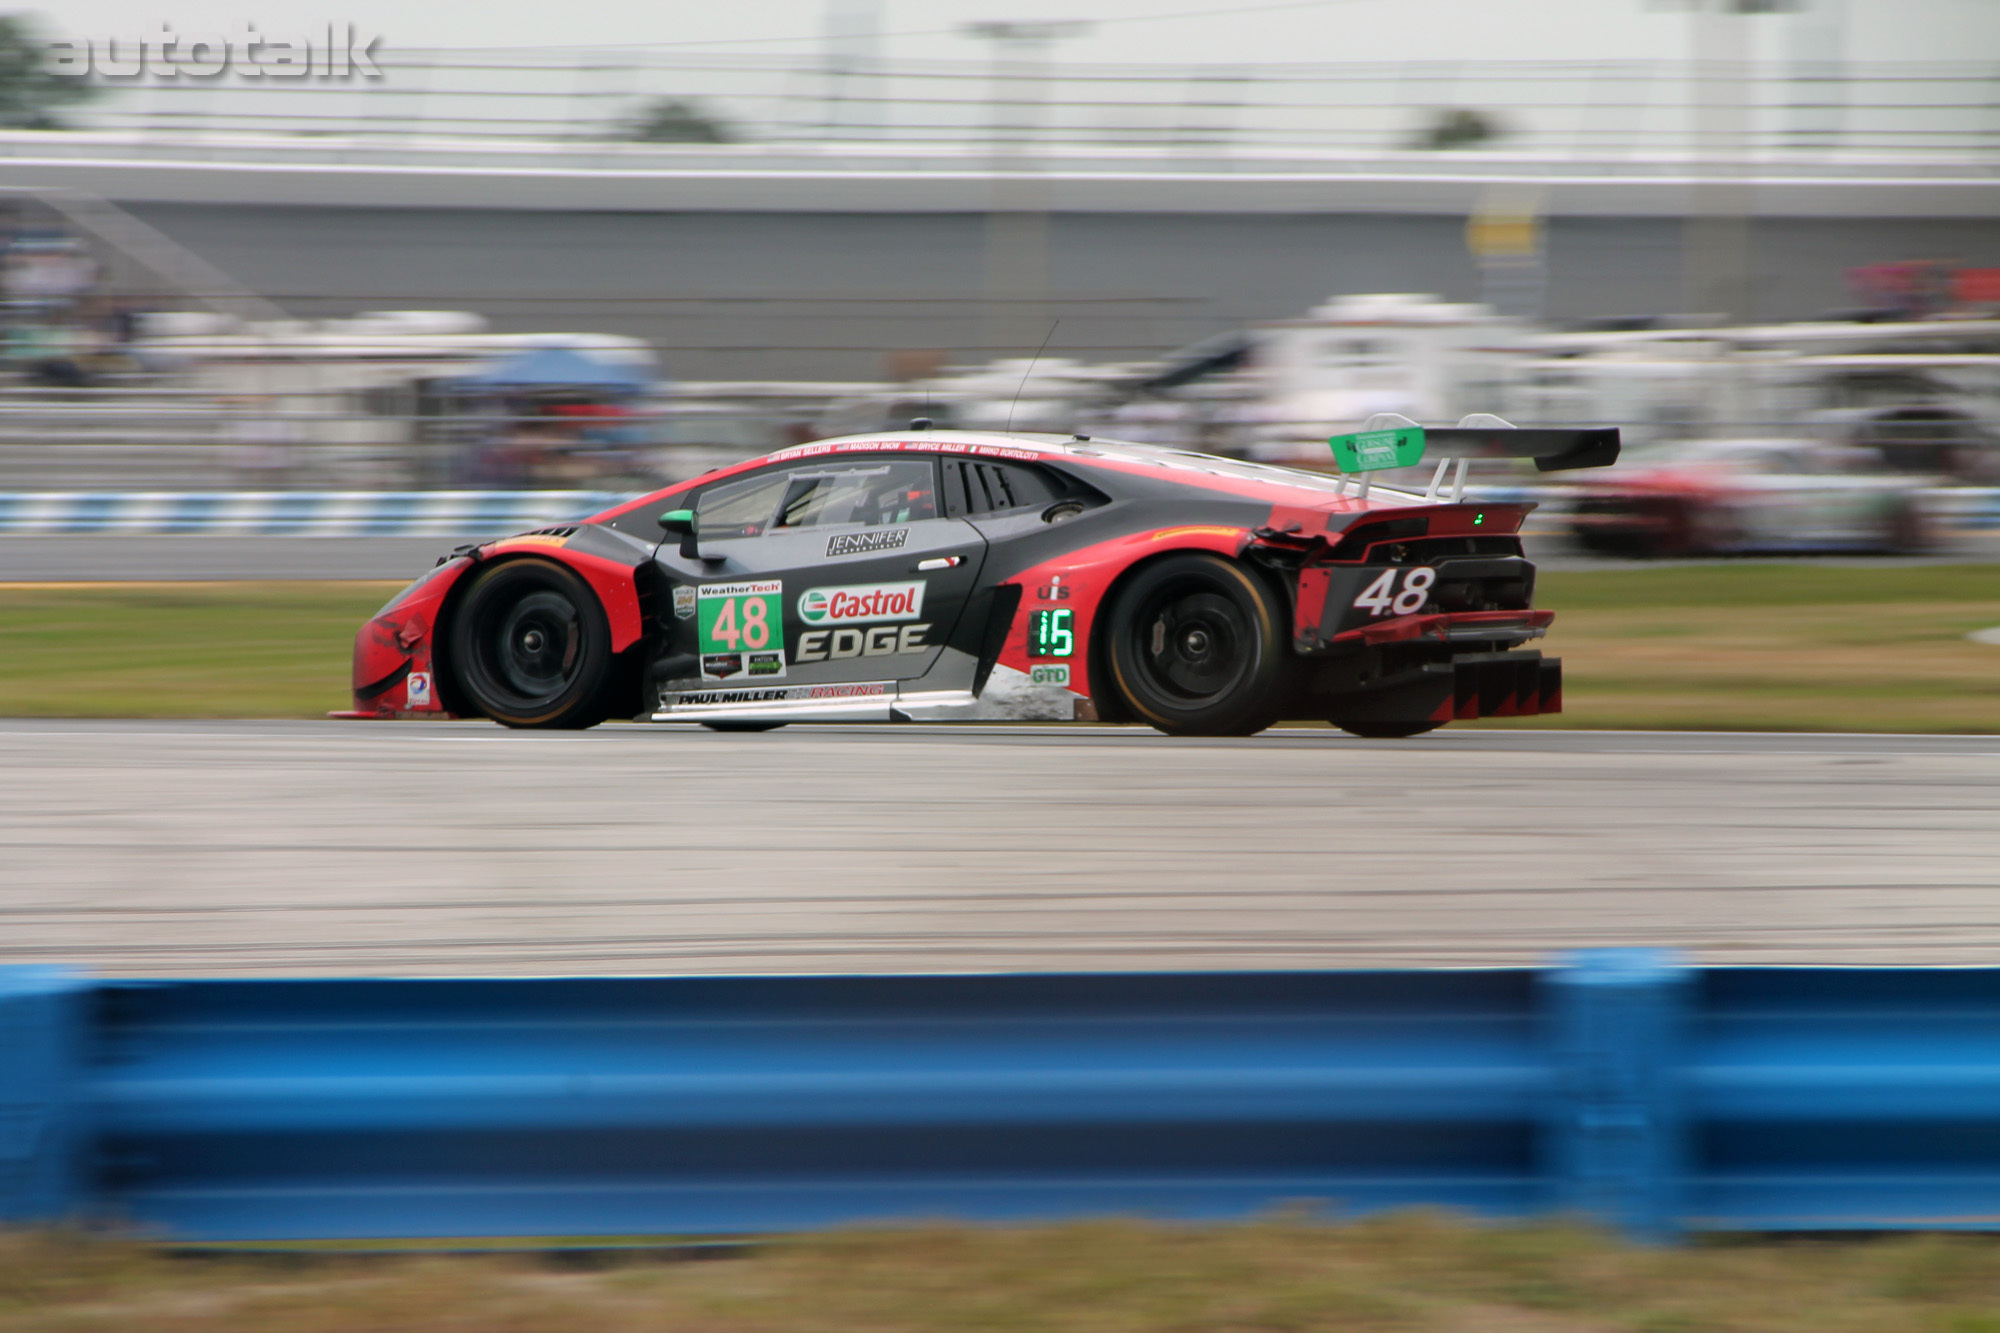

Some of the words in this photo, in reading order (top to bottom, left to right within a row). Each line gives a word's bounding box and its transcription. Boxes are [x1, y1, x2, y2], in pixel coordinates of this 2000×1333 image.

[781, 450, 802, 461] BRYAN
[803, 445, 831, 456] SELLERS
[850, 442, 879, 450] MADISON
[880, 442, 900, 450] SNOW
[918, 442, 940, 451] BRYCE
[941, 444, 965, 452] MILLER
[979, 446, 1000, 455] MIRKO
[1000, 449, 1039, 460] BORTOLOTTI
[829, 530, 905, 551] JENNIFER
[702, 583, 780, 595] WeatherTech
[1353, 567, 1436, 616] 48
[830, 587, 915, 618] Castrol
[711, 597, 770, 650] 48
[795, 623, 933, 662] EDGE
[1032, 668, 1067, 683] GTD
[678, 693, 720, 705] PAUL
[721, 690, 788, 704] MILLER
[810, 684, 884, 699] RACING
